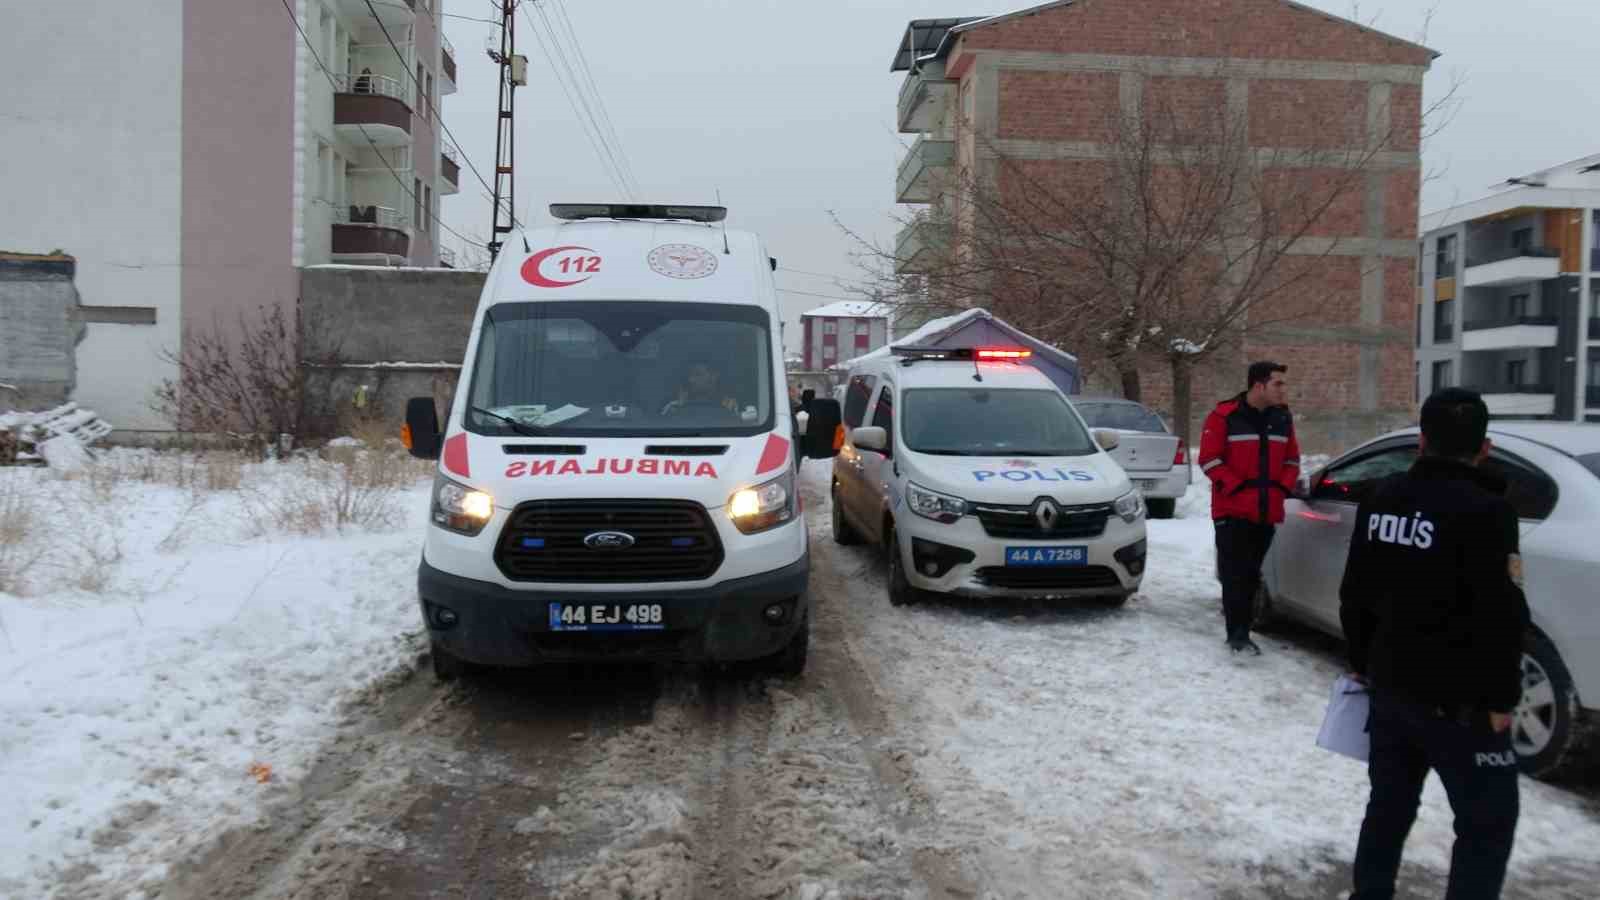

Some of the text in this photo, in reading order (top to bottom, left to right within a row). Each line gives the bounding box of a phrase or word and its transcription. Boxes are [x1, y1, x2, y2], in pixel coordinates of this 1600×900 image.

[559, 256, 602, 273] 112
[972, 468, 1095, 482] POLİS
[1367, 511, 1435, 550] POLİS
[1011, 549, 1029, 561] 44
[1033, 549, 1044, 561] A
[561, 604, 662, 624] 44 EJ 498
